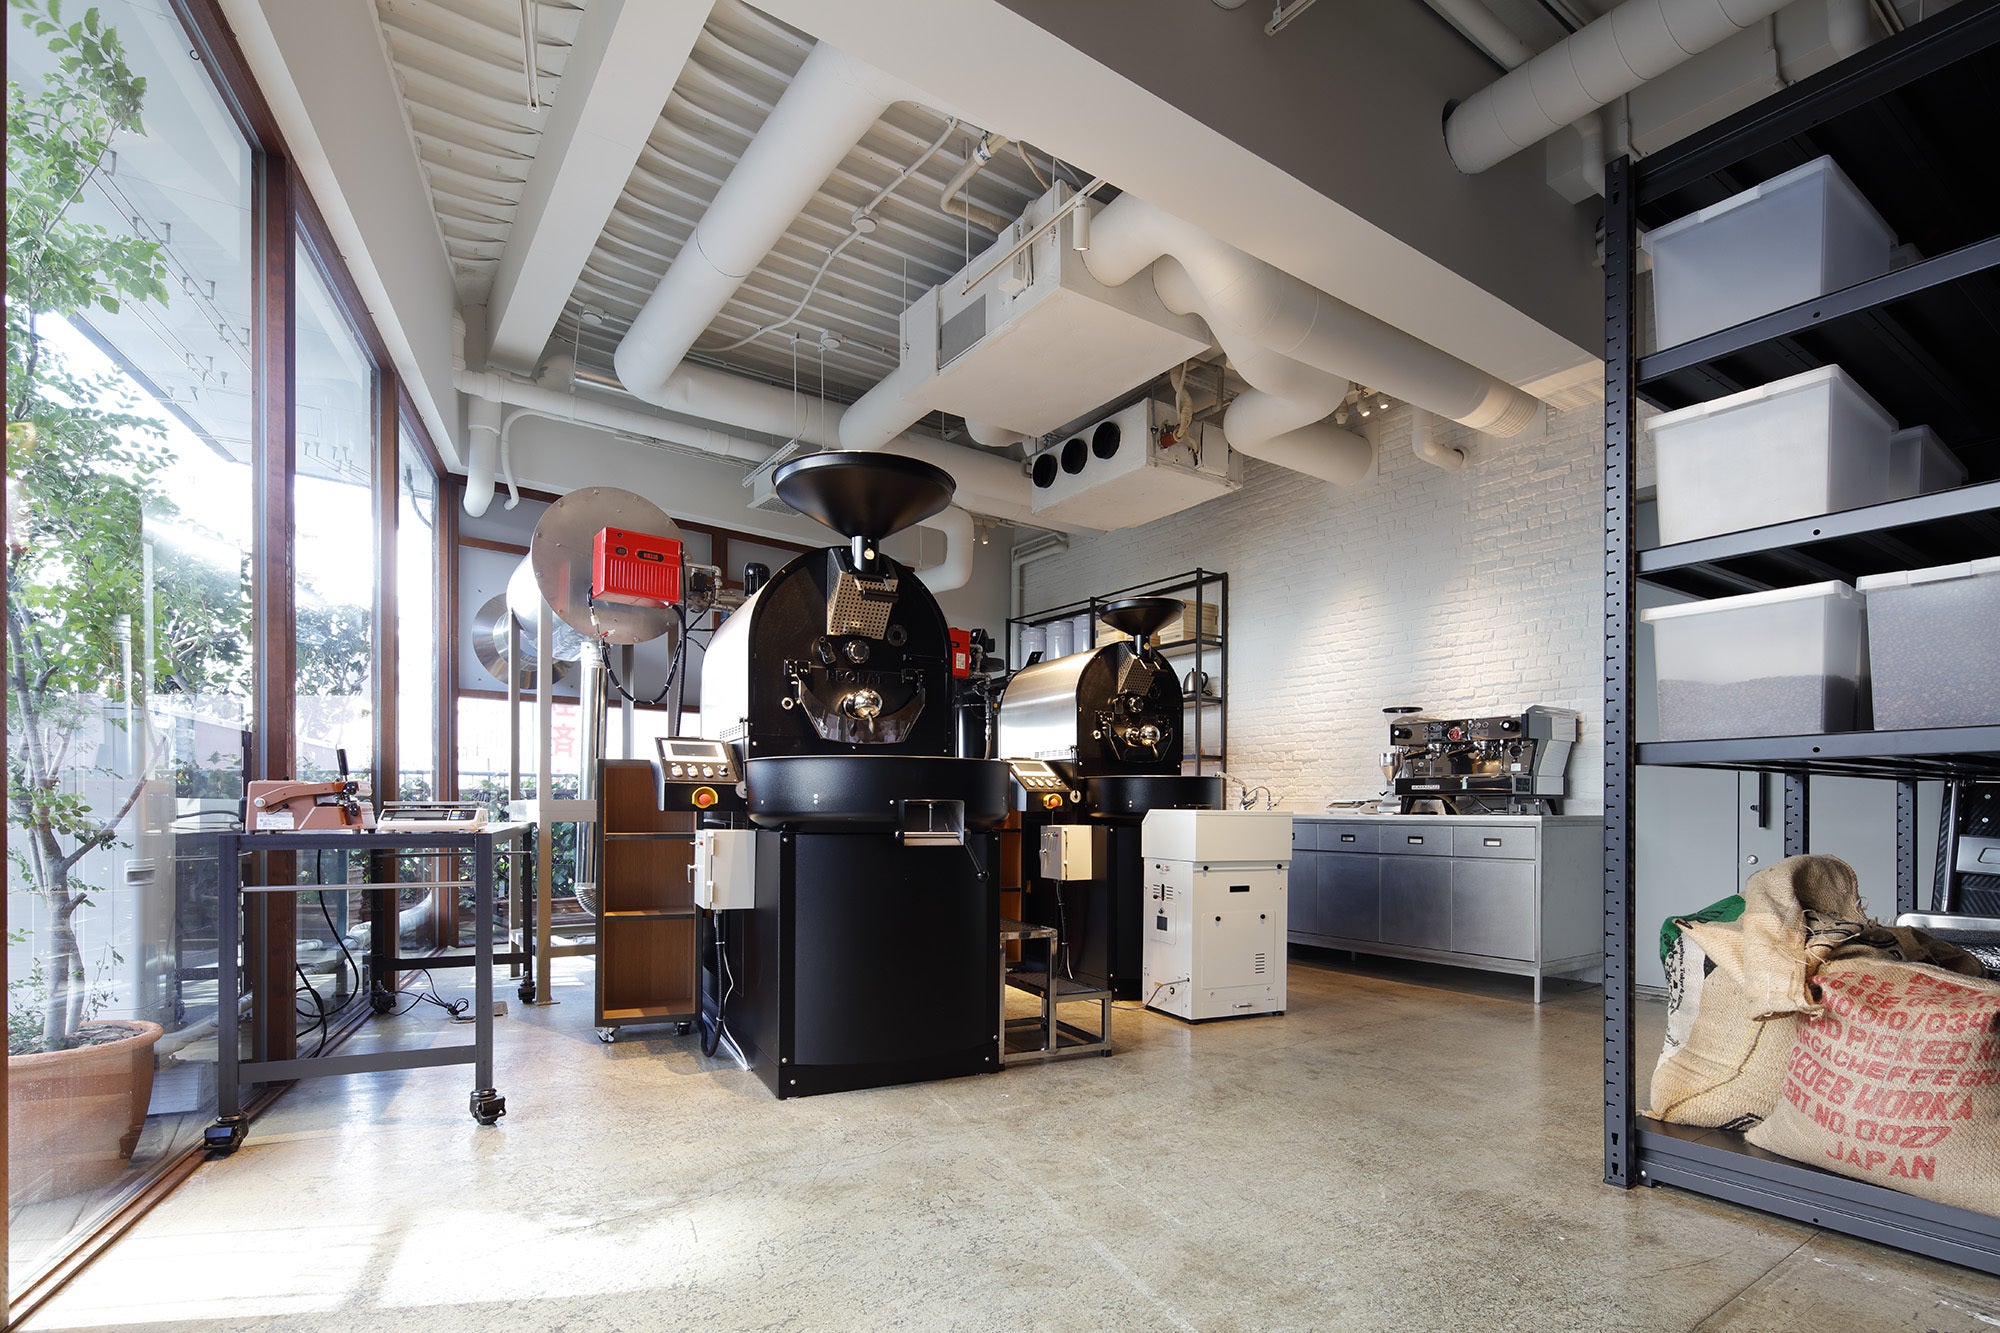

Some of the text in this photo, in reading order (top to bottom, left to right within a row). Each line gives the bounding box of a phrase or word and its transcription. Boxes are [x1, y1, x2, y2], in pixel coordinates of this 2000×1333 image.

[1845, 1026, 1972, 1065] PICKED
[1852, 1083, 1973, 1121] WORKA
[1825, 1141, 1937, 1182] JAPAN
